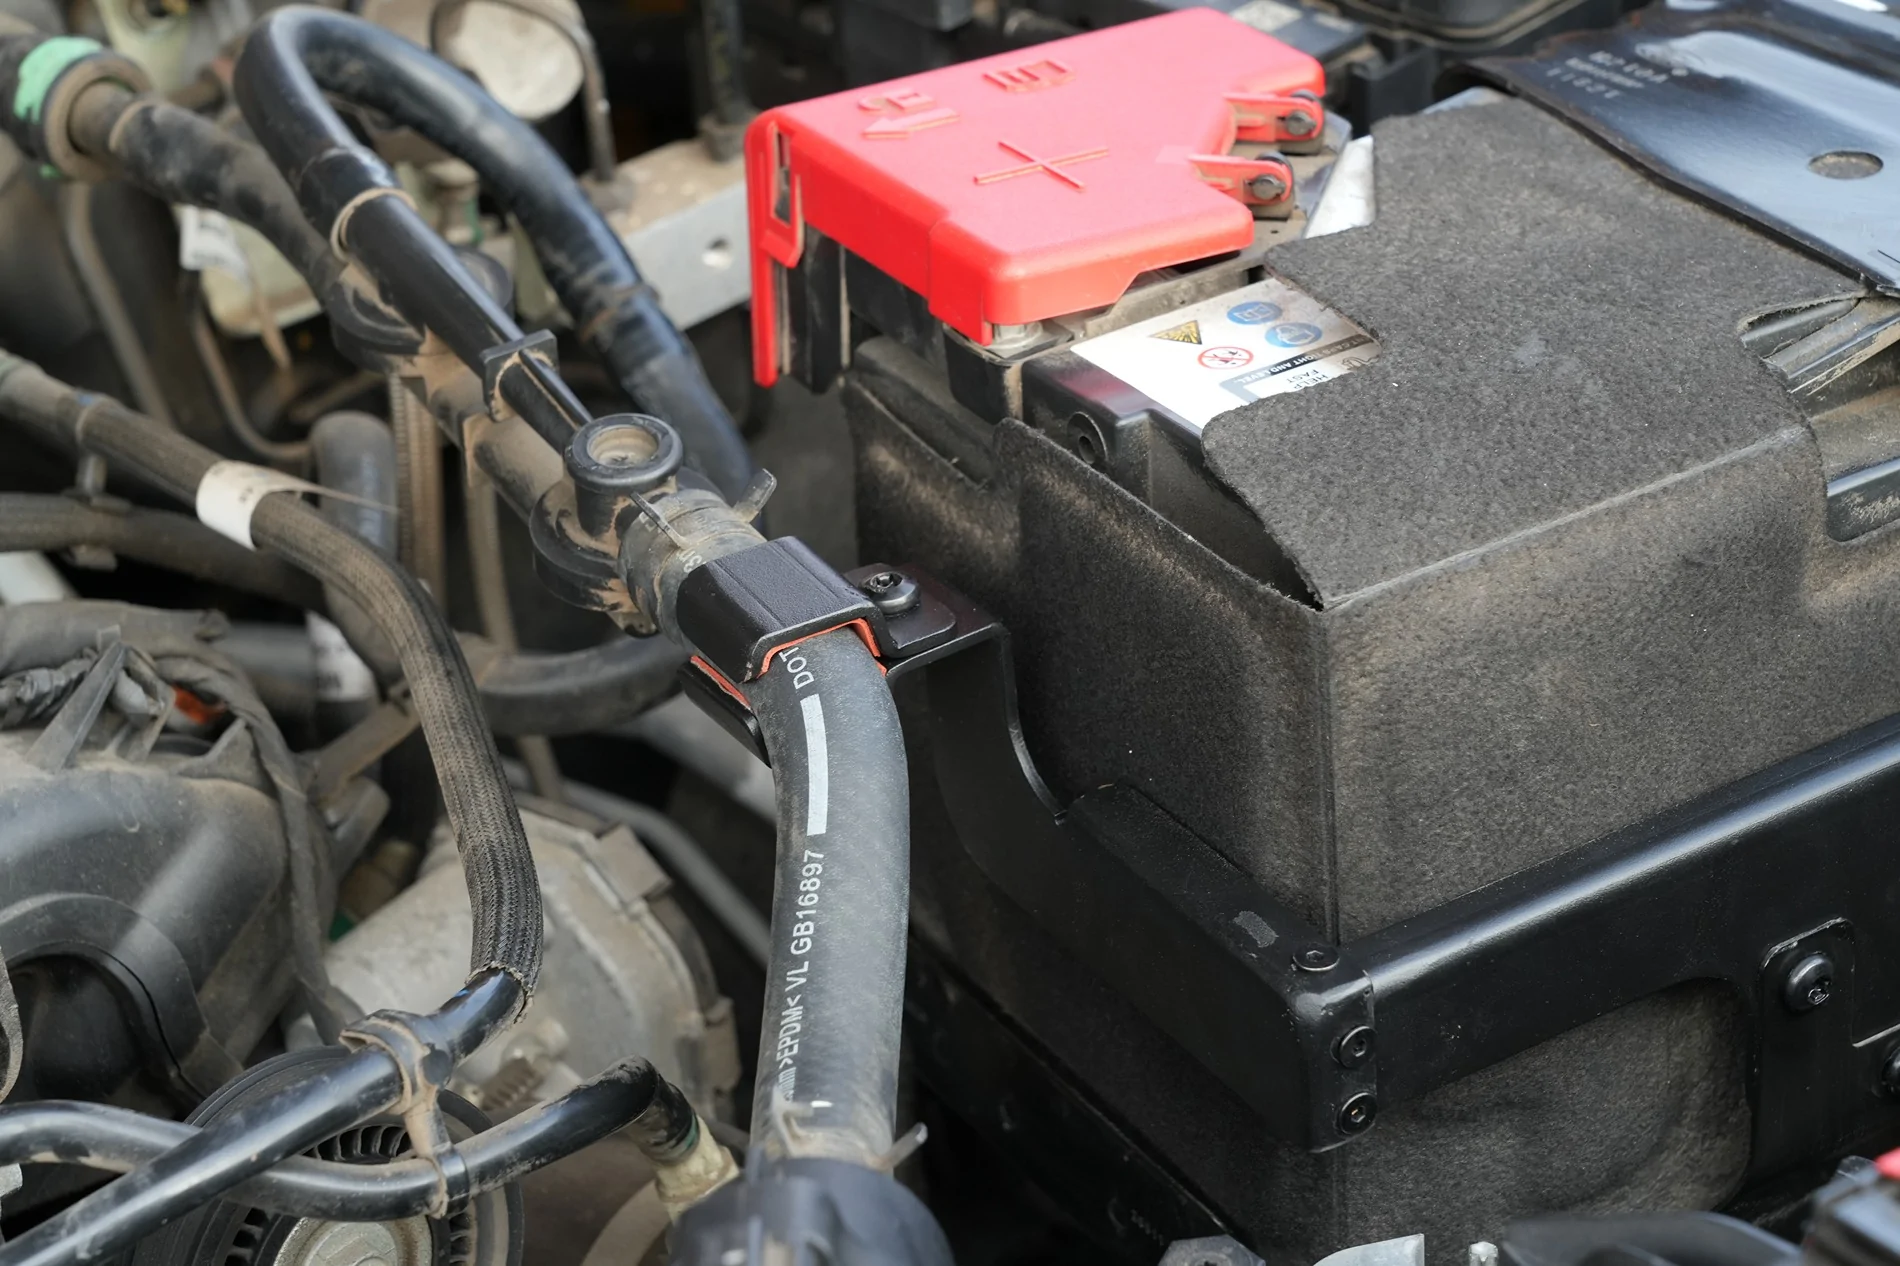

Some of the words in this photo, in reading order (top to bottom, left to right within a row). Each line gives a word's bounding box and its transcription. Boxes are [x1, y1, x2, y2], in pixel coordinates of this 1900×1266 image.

[1270, 362, 1292, 374] AND
[1287, 369, 1320, 383] FAST
[1294, 374, 1328, 390] HELP
[778, 646, 815, 690] DOT
[790, 849, 825, 955] GB16897
[784, 960, 809, 992] VL
